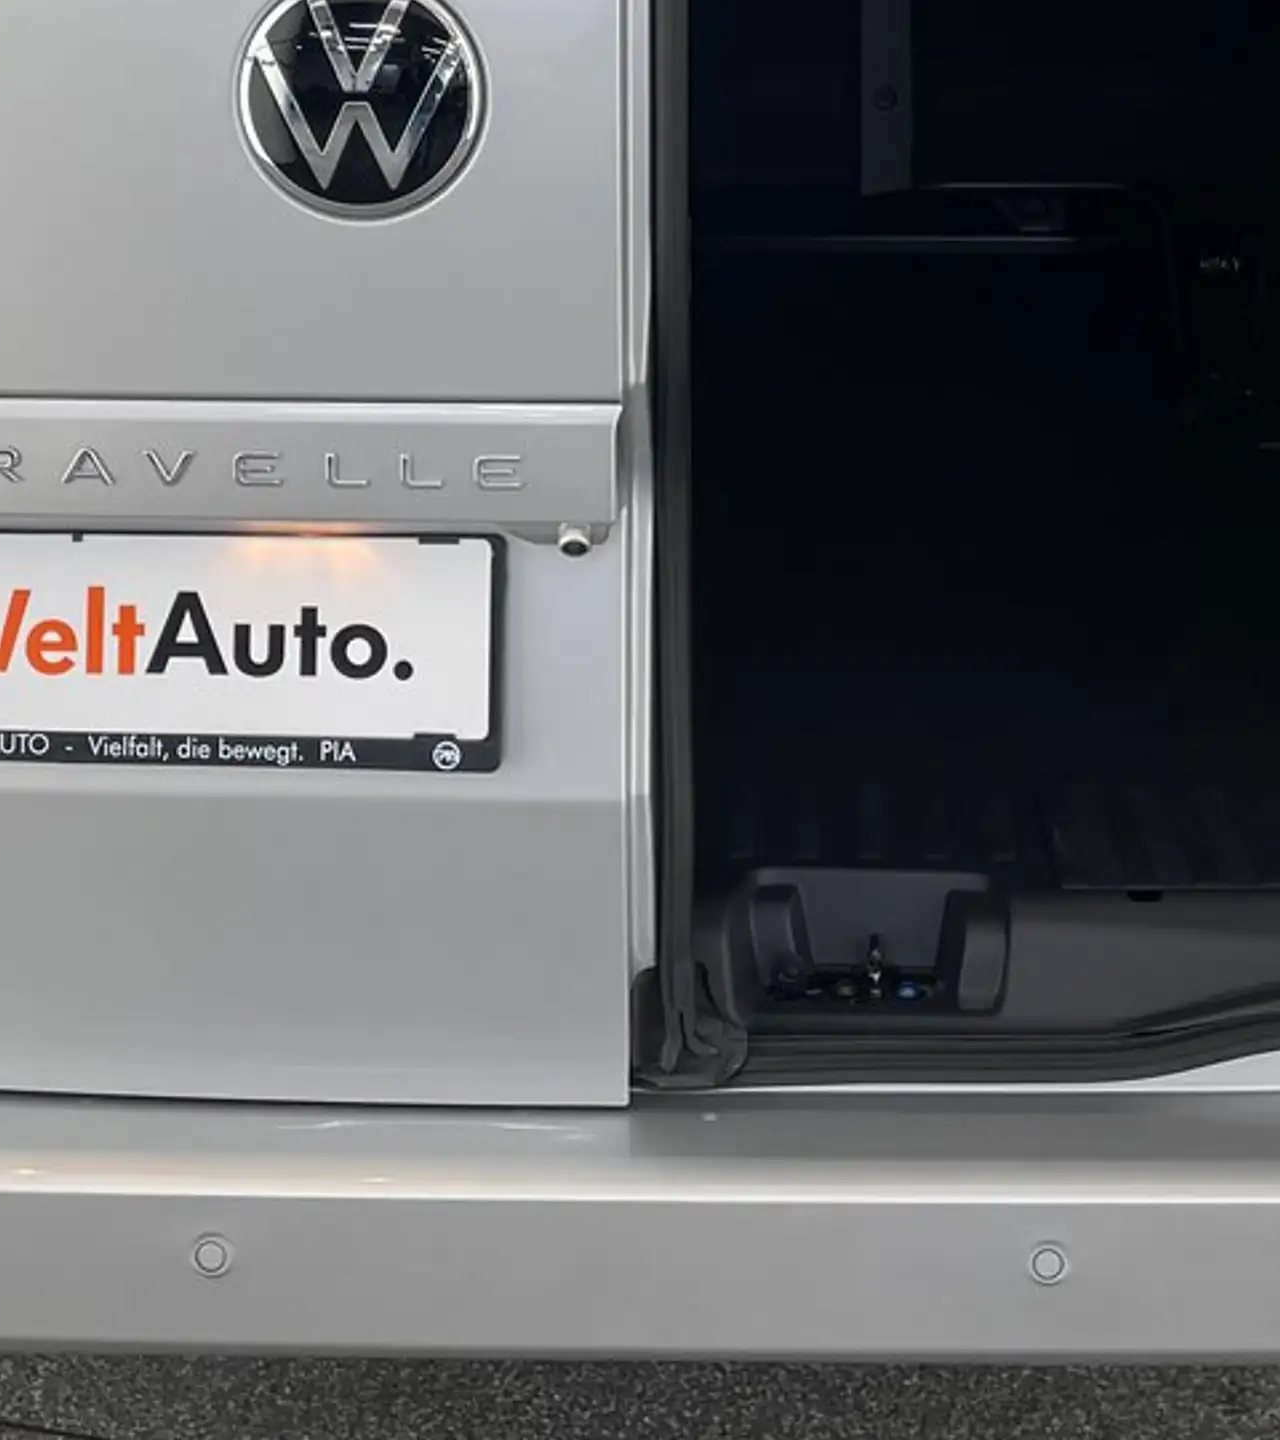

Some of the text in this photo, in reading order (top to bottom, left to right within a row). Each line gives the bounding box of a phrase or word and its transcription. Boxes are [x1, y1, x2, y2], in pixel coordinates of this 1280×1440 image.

[88, 734, 170, 762] Vielfalt,
[177, 737, 211, 759] die
[218, 739, 304, 766] bewegt.
[320, 741, 356, 763] PIA
